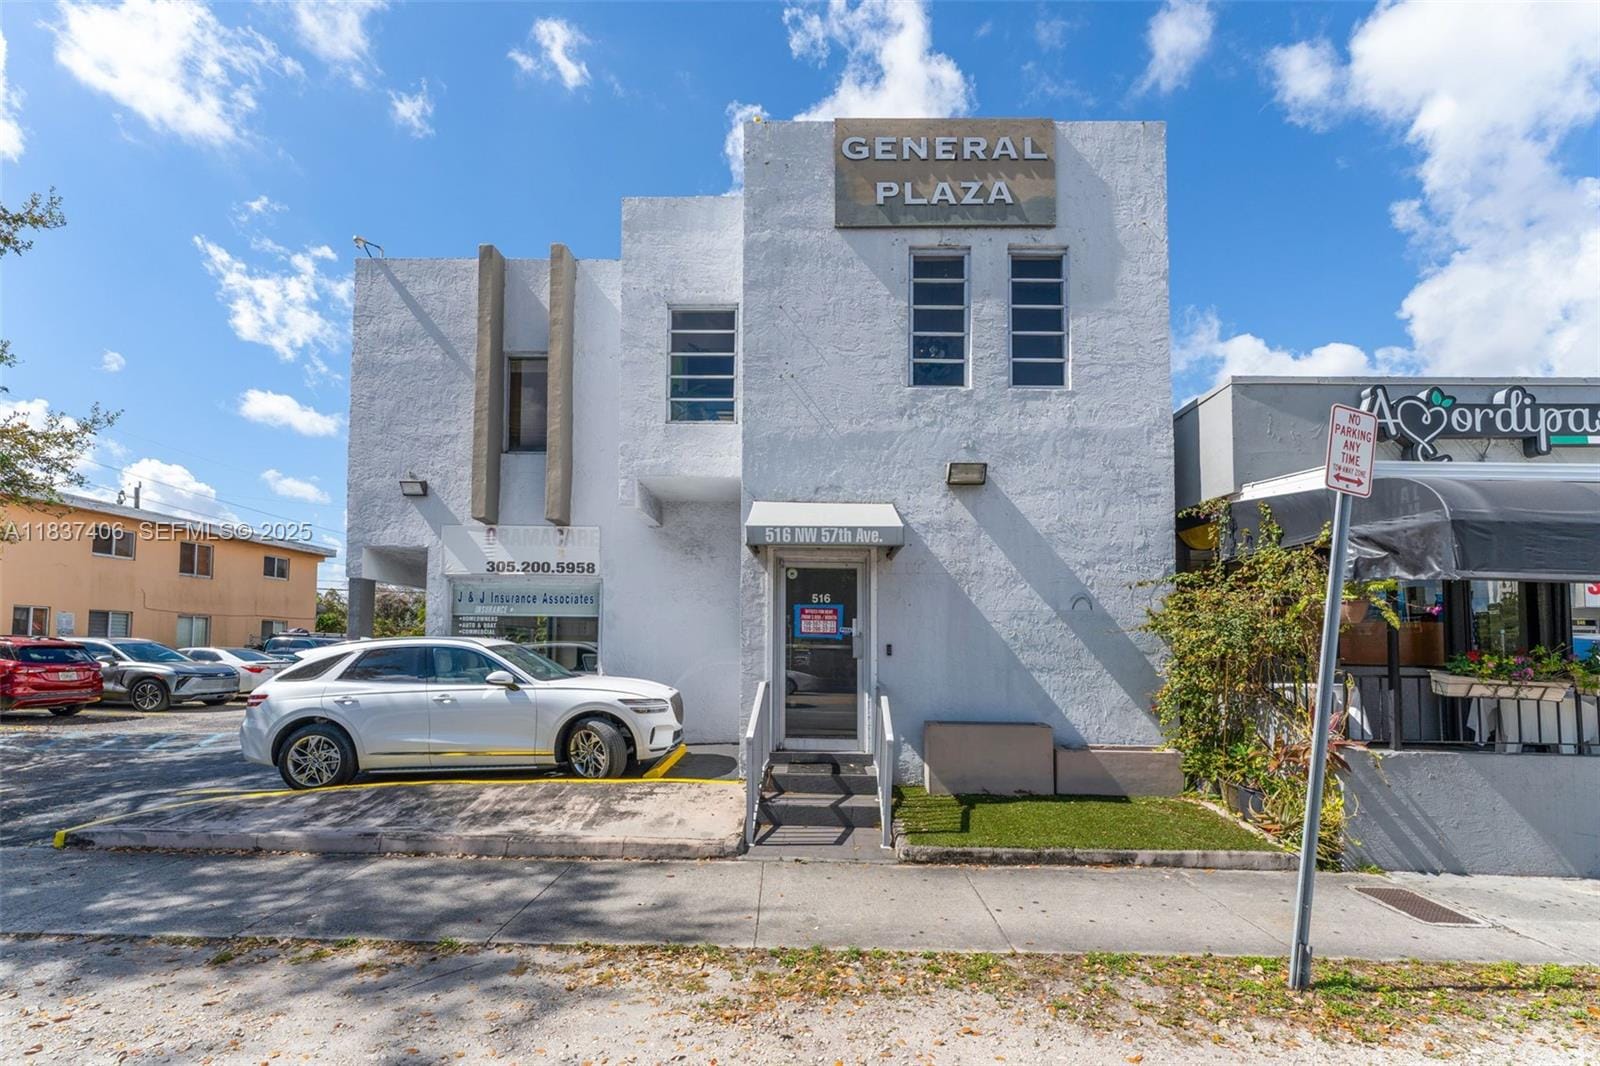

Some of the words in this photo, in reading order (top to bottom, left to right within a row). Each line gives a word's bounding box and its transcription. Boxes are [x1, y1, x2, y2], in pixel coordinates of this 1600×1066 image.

[841, 136, 1048, 160] GENERAL
[876, 181, 1014, 205] PLAZA
[1348, 413, 1361, 426] NO
[1335, 423, 1372, 443] PARKING
[1343, 440, 1361, 453] ANY
[1341, 452, 1360, 467] TIME
[765, 527, 791, 543] 516
[794, 528, 817, 543] NW
[821, 528, 852, 543] 57th
[855, 528, 883, 543] Ave.
[486, 560, 596, 574] 305.200.5958
[458, 592, 463, 603] J
[468, 592, 475, 603] &
[479, 592, 485, 604] J
[490, 592, 537, 604] Insurance
[542, 593, 594, 605] Associates
[811, 593, 831, 603] 516
